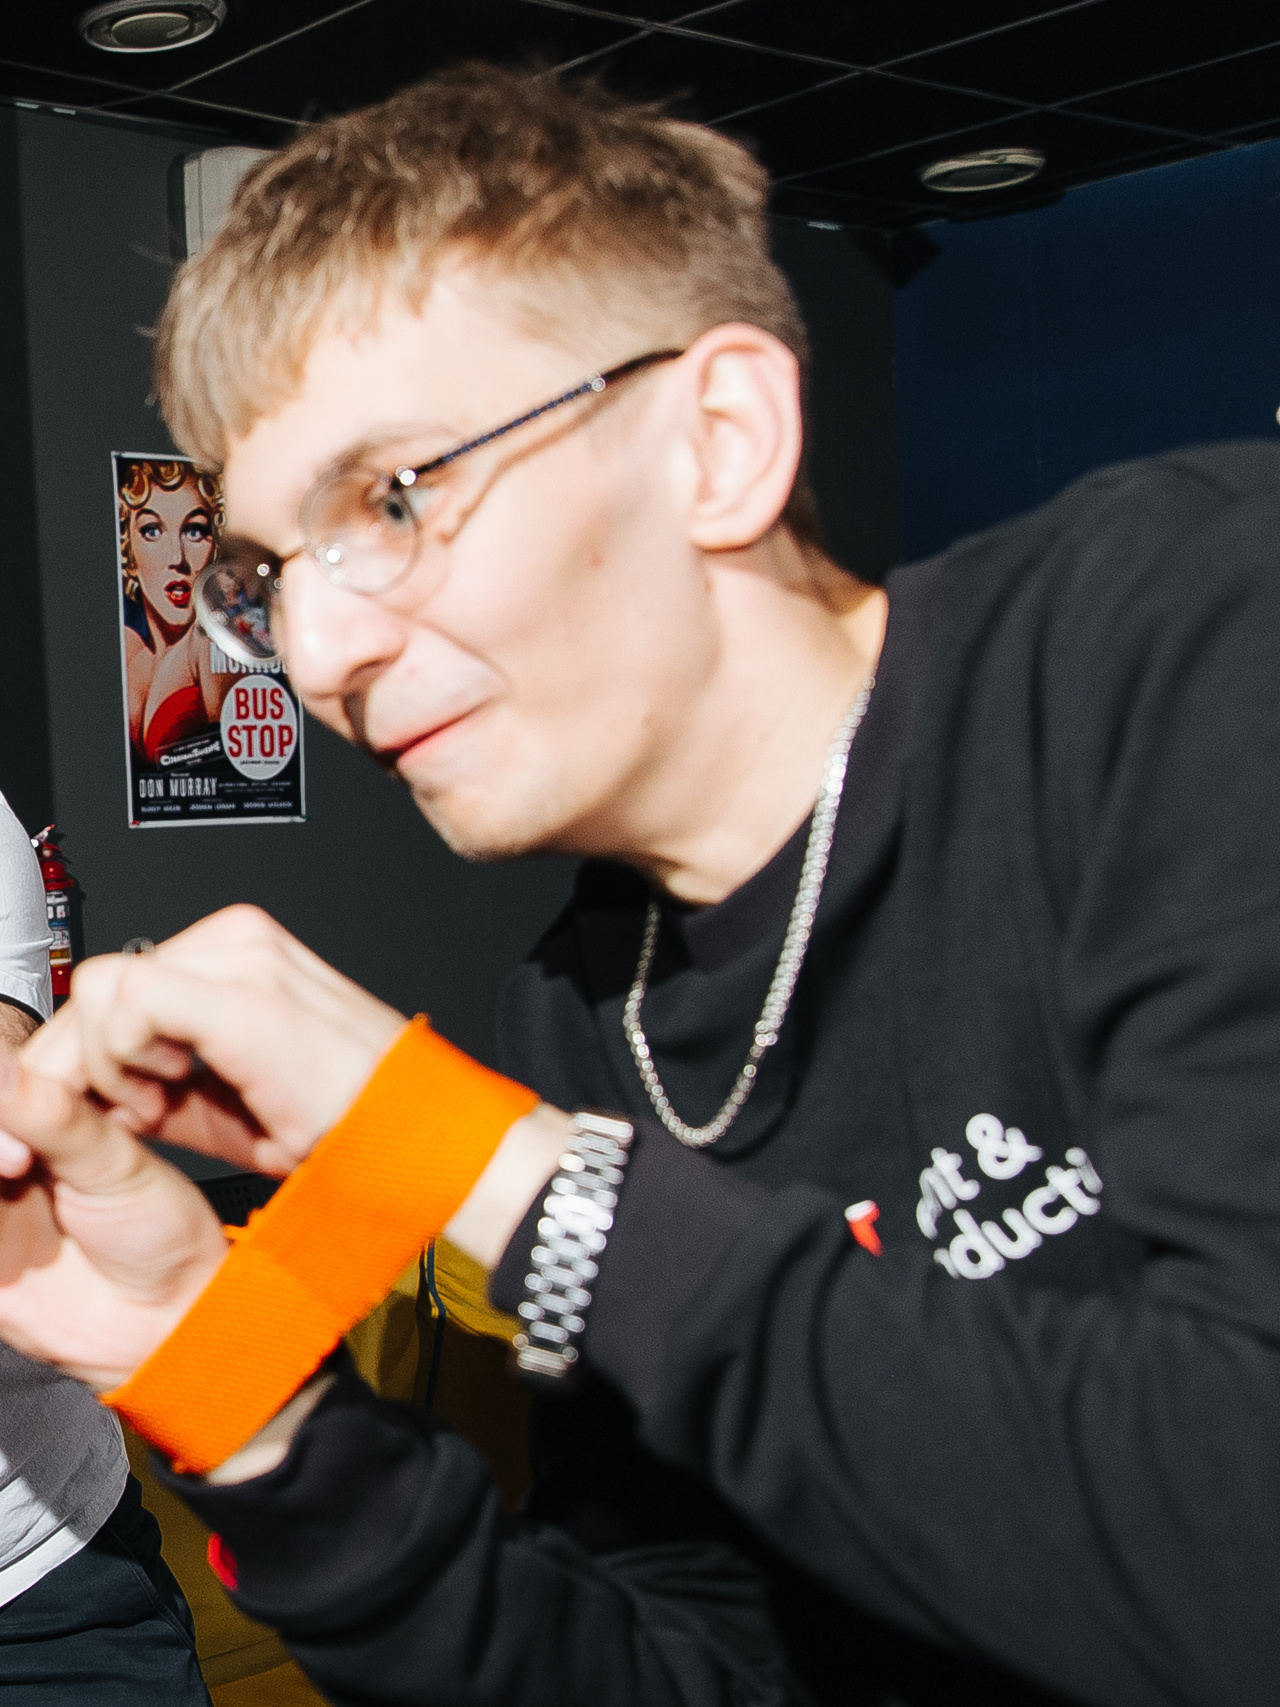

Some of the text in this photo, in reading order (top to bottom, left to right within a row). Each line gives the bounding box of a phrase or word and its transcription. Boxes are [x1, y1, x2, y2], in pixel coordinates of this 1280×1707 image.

[234, 687, 284, 721] BUS
[227, 724, 294, 758] STOP
[139, 777, 218, 798] DON MURRAY
[966, 1113, 1044, 1180] &
